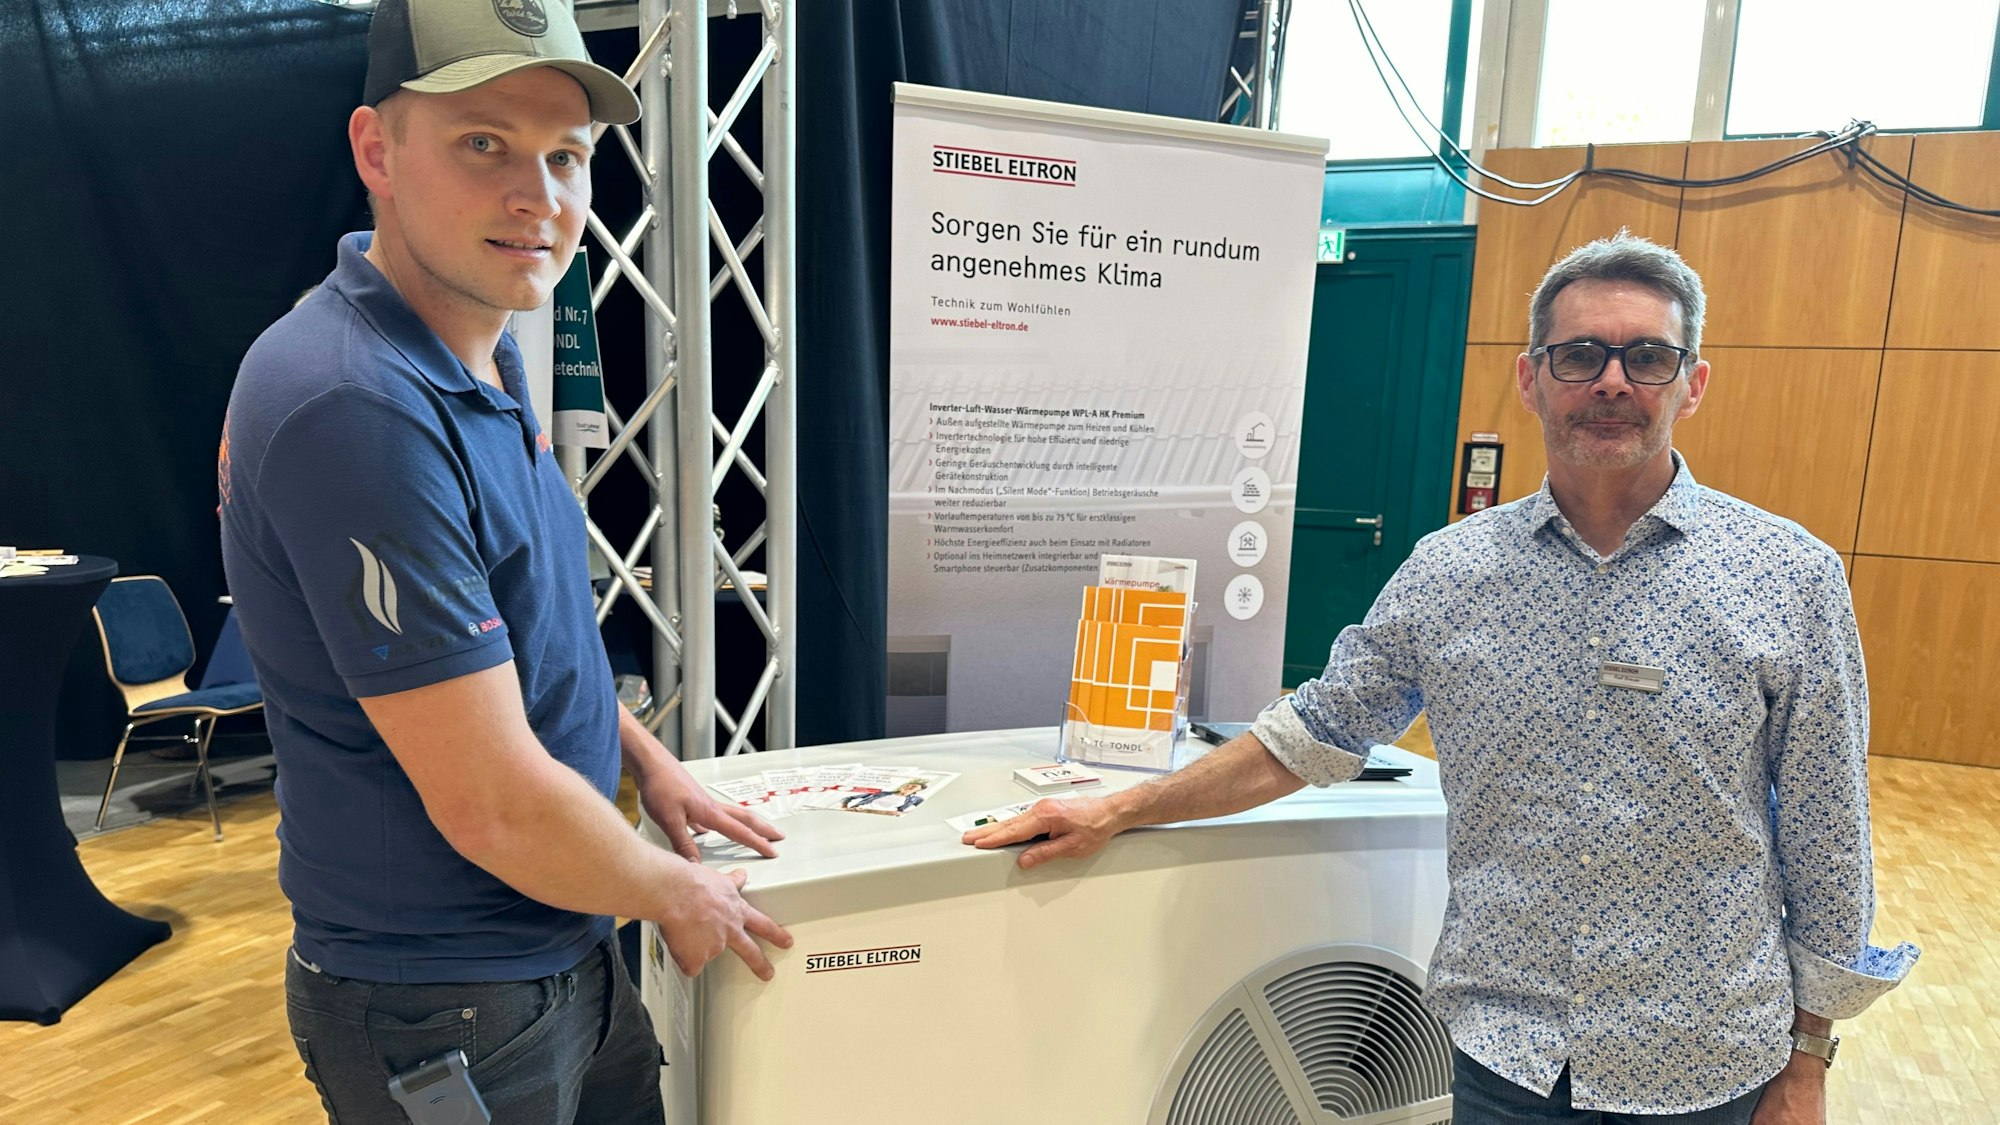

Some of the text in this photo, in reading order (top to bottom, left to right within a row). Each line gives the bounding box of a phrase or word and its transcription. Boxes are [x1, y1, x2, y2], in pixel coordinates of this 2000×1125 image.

[933, 150, 1077, 182] STIEBEL ELTRON
[931, 211, 1260, 262] Sorgen Sie für ein rundum
[931, 252, 1163, 288] angenehmes Klima
[931, 296, 1071, 316] Technik zum Wohlfühlen
[931, 317, 1029, 331] www.stiebel-eltron.de
[554, 333, 581, 349] NDL
[554, 361, 600, 377] etechnik
[929, 403, 1145, 419] Inverter-Luft-Wasser-Wärmepumpe WPL-A HK Premium
[936, 417, 963, 427] Außen
[965, 418, 1010, 429] aufgestellte
[1011, 420, 1066, 431] Wärmepumpe
[1085, 423, 1111, 432] Heizen
[1113, 424, 1127, 432] und
[1129, 424, 1155, 433] Kühlen
[936, 432, 1129, 447] Invertertechnologie für hohe Effizienz und niedrige
[936, 444, 991, 455] Energiekosten
[935, 458, 1118, 473] Geringe Geräuschentwicklung durch intelligente
[935, 471, 1009, 481] Gerätekonstruktion
[935, 486, 945, 494] Im
[1092, 488, 1159, 499] Betriebsgeräusche
[935, 499, 1007, 507] weiter reduzierbar
[934, 512, 1014, 522] Vorlauftemperaturen
[1032, 513, 1044, 521] bis
[1077, 513, 1088, 521] für
[1089, 514, 1136, 524] erstklassigen
[934, 524, 1014, 533] Warmwasserkomfort
[934, 538, 1151, 548] Höchste Energieeffizienz auch beim Einsatz mit Radiatoren
[933, 551, 967, 562] Optional
[969, 551, 981, 560] ins
[982, 552, 1036, 560] Heimnetzwerk
[1038, 551, 1082, 561] integrierbar
[1084, 551, 1099, 560] und
[933, 563, 981, 574] Smartphone
[983, 564, 1019, 573] steuerbar
[1021, 563, 1098, 574] (Zusatzkomponenten
[1104, 577, 1161, 589] Wärmepumpe
[1110, 742, 1143, 752] TONDL
[806, 948, 921, 970] STIEBEL ELTRON
